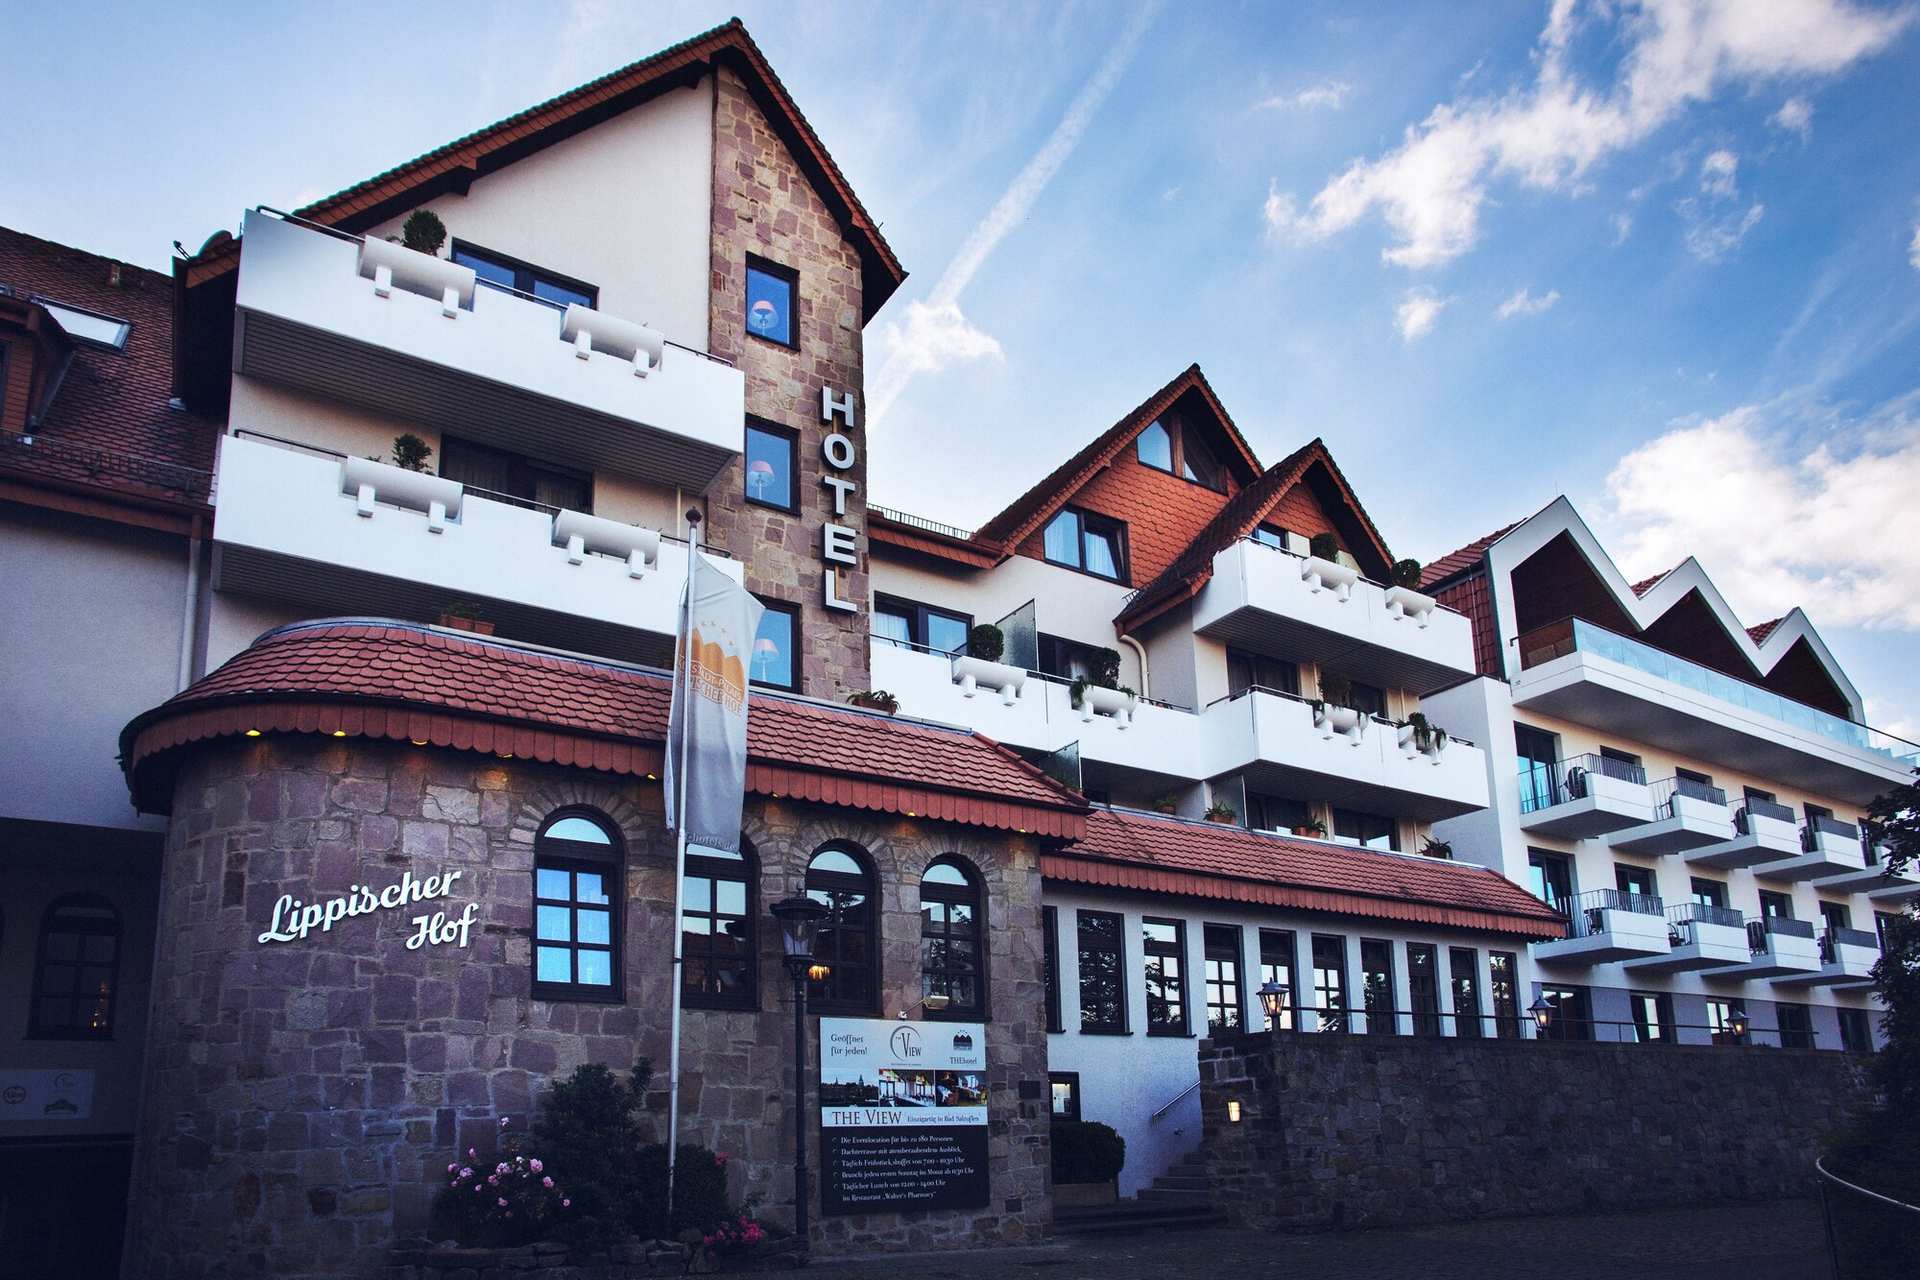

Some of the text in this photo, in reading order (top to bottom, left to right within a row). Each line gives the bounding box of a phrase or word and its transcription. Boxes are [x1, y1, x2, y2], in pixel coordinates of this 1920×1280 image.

[821, 385, 858, 613] HOTEL
[258, 871, 462, 944] Lippischer
[405, 903, 479, 950] Hof
[830, 1033, 864, 1044] Geöffnet
[831, 1046, 868, 1056] für jeden!
[832, 1109, 902, 1125] THE VIEW
